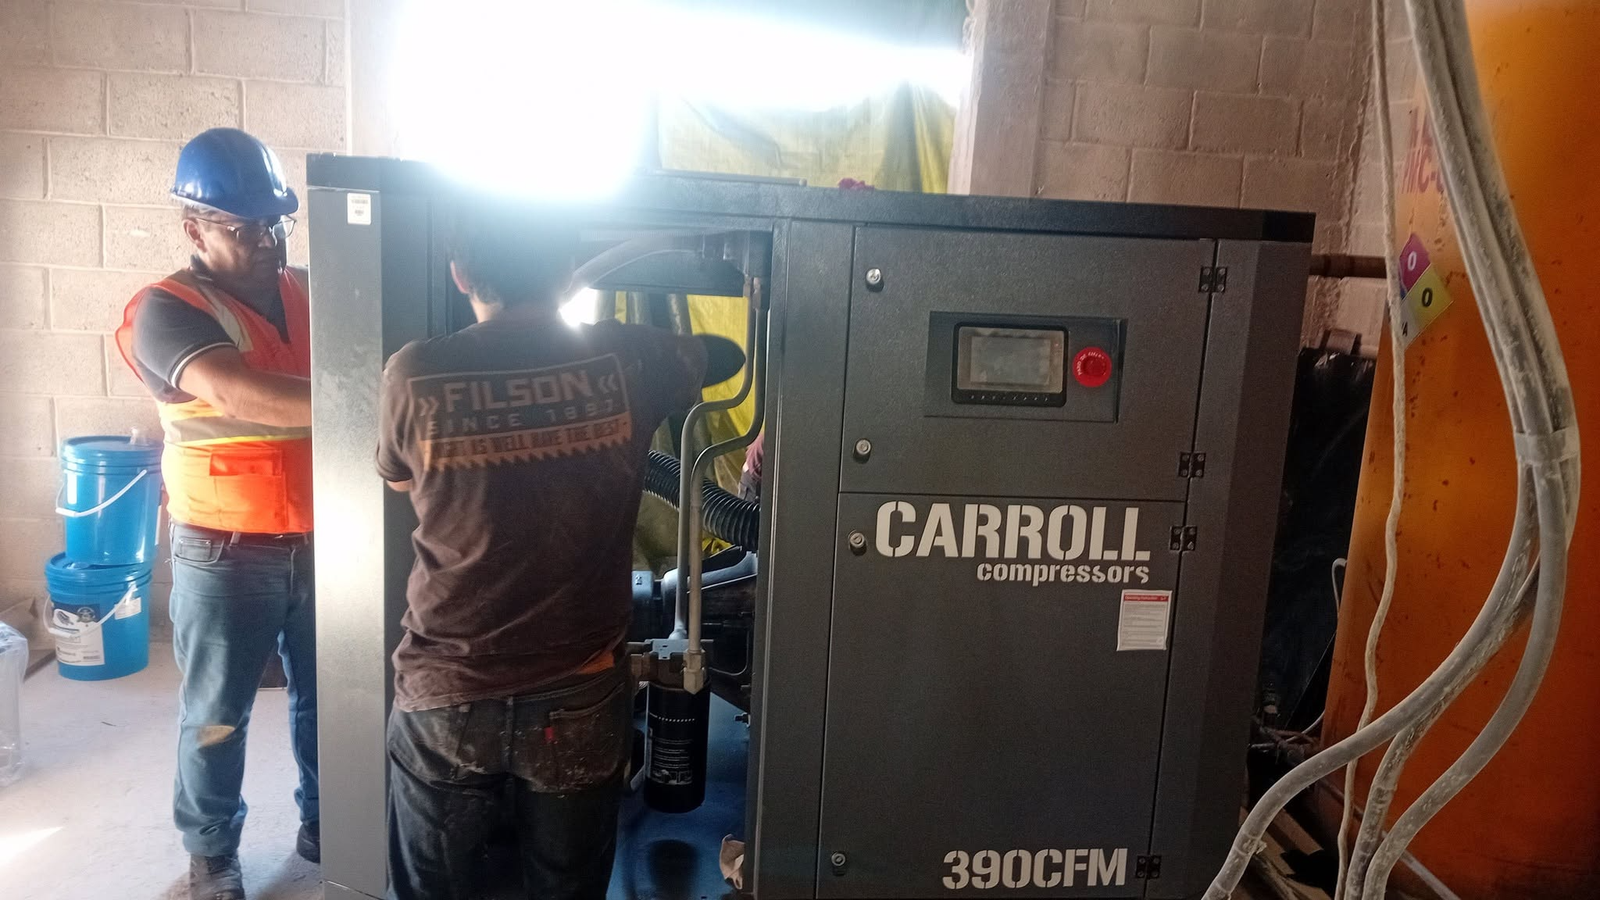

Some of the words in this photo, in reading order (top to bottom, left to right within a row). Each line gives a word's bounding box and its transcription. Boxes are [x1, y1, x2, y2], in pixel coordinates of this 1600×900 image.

[1407, 251, 1417, 271] 0
[1421, 287, 1433, 307] 0
[444, 369, 594, 412] FILSON
[875, 501, 1150, 561] CARROLL
[976, 563, 1150, 586] compressors
[942, 848, 1128, 889] 390CFM
